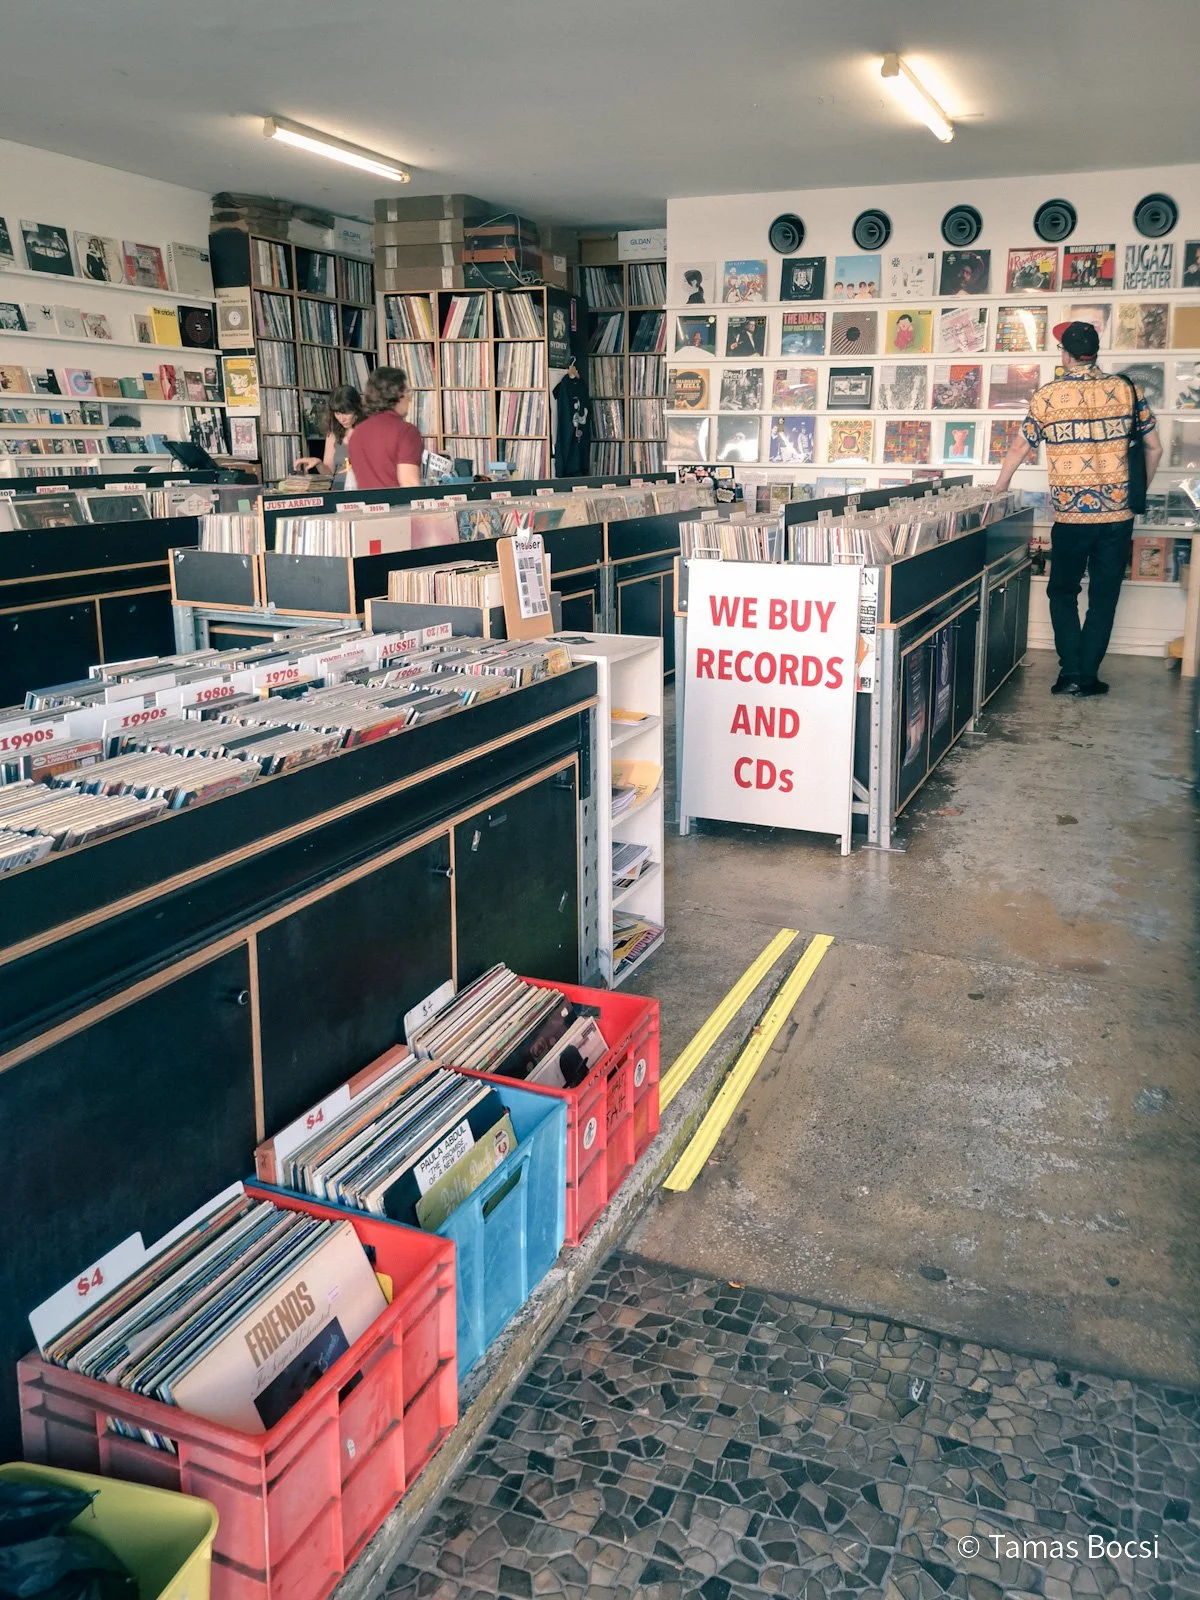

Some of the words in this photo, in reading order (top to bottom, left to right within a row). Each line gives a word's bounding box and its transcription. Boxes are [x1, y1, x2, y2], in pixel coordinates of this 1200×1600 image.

[1125, 244, 1174, 272] FUGAZI
[1123, 271, 1171, 290] REPEATER
[783, 313, 798, 325] THE
[798, 312, 824, 325] DRAGS
[266, 500, 286, 509] JUST
[288, 498, 322, 508] ARRIVED
[709, 595, 758, 629] WE
[768, 598, 837, 633] BUY
[382, 638, 417, 657] AUSSIE
[266, 668, 300, 684] 1970s
[394, 665, 423, 680] 1960s
[696, 648, 844, 690] RECORDS
[196, 685, 236, 703] 1980s
[121, 707, 168, 728] 1990s
[730, 704, 800, 739] AND
[0, 728, 54, 751] 1990s
[734, 757, 794, 793] CDs
[306, 1108, 324, 1130] $4
[420, 1147, 443, 1172] PAULA
[444, 1125, 467, 1149] ABDUL
[442, 1139, 465, 1163] PROMISE
[443, 1157, 455, 1171] NEW
[76, 1267, 104, 1297] $4
[244, 1280, 316, 1369] FRIENDS
